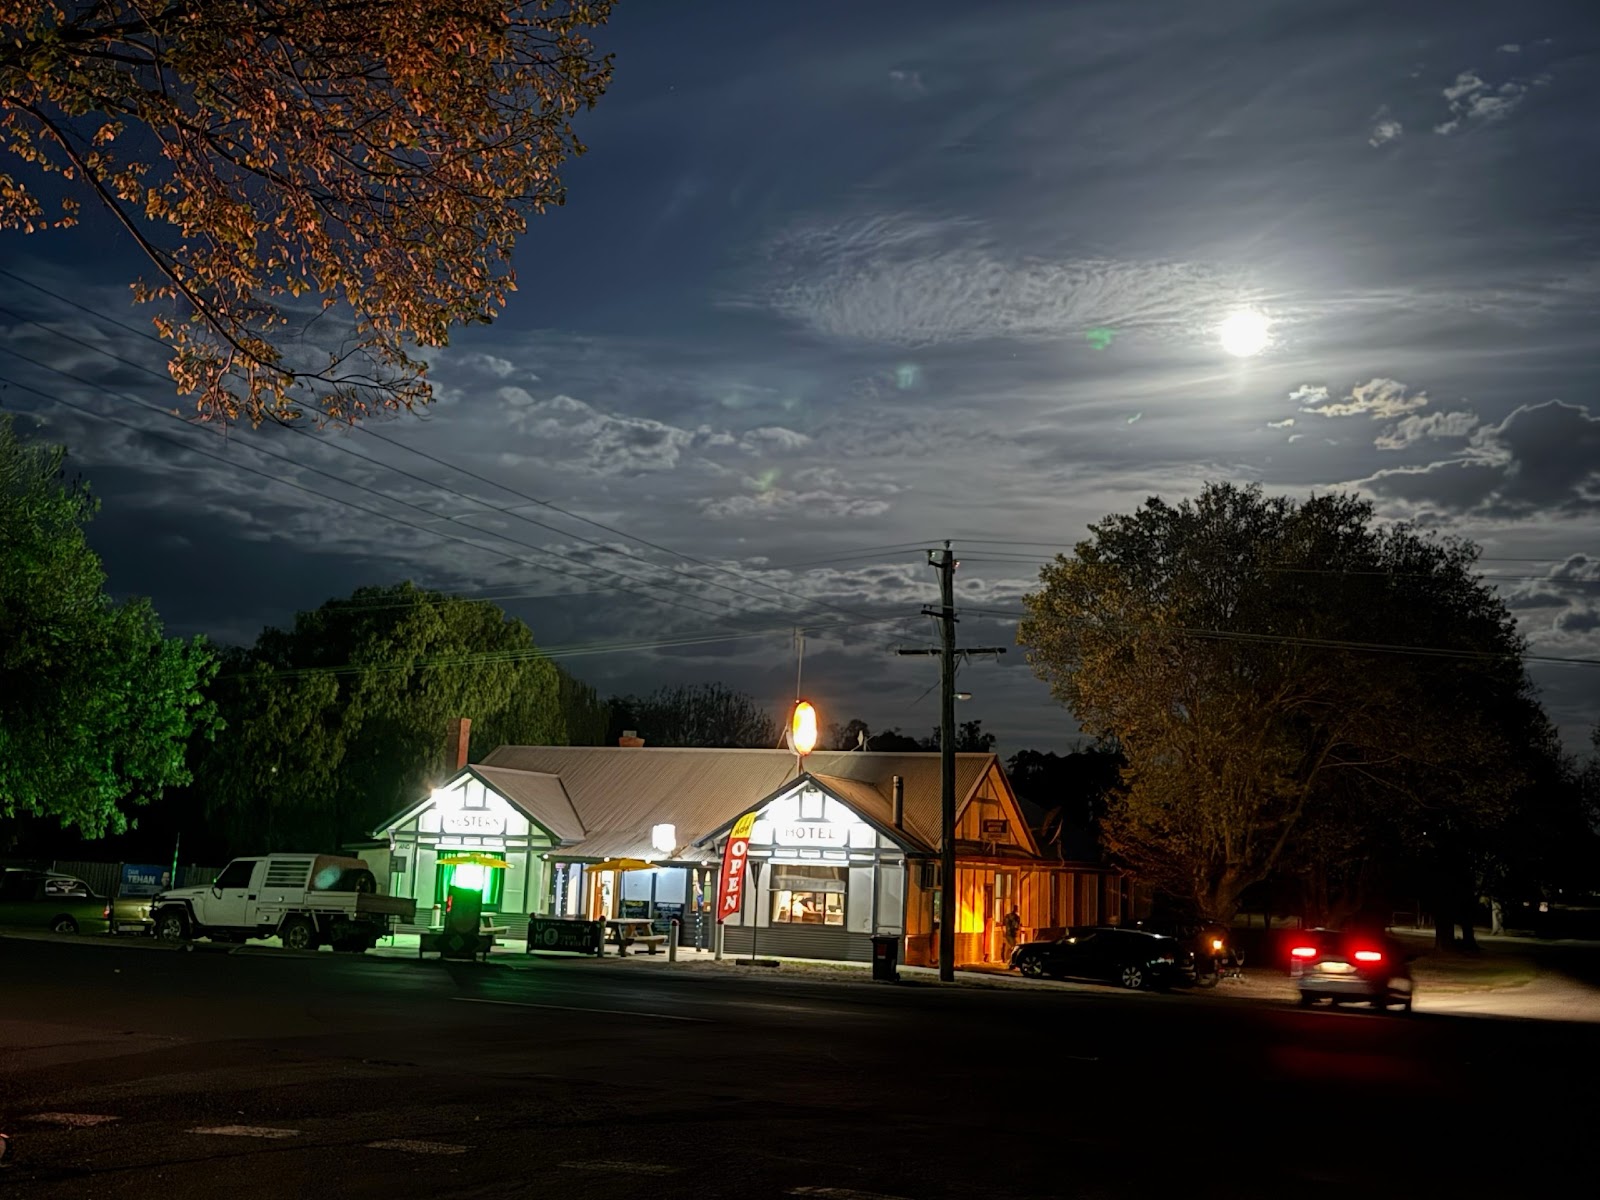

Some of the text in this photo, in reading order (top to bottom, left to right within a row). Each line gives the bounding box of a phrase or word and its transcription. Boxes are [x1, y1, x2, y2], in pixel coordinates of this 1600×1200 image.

[785, 827, 836, 839] HOTEL
[128, 875, 156, 884] TEHAN
[723, 840, 747, 910] OPEN
